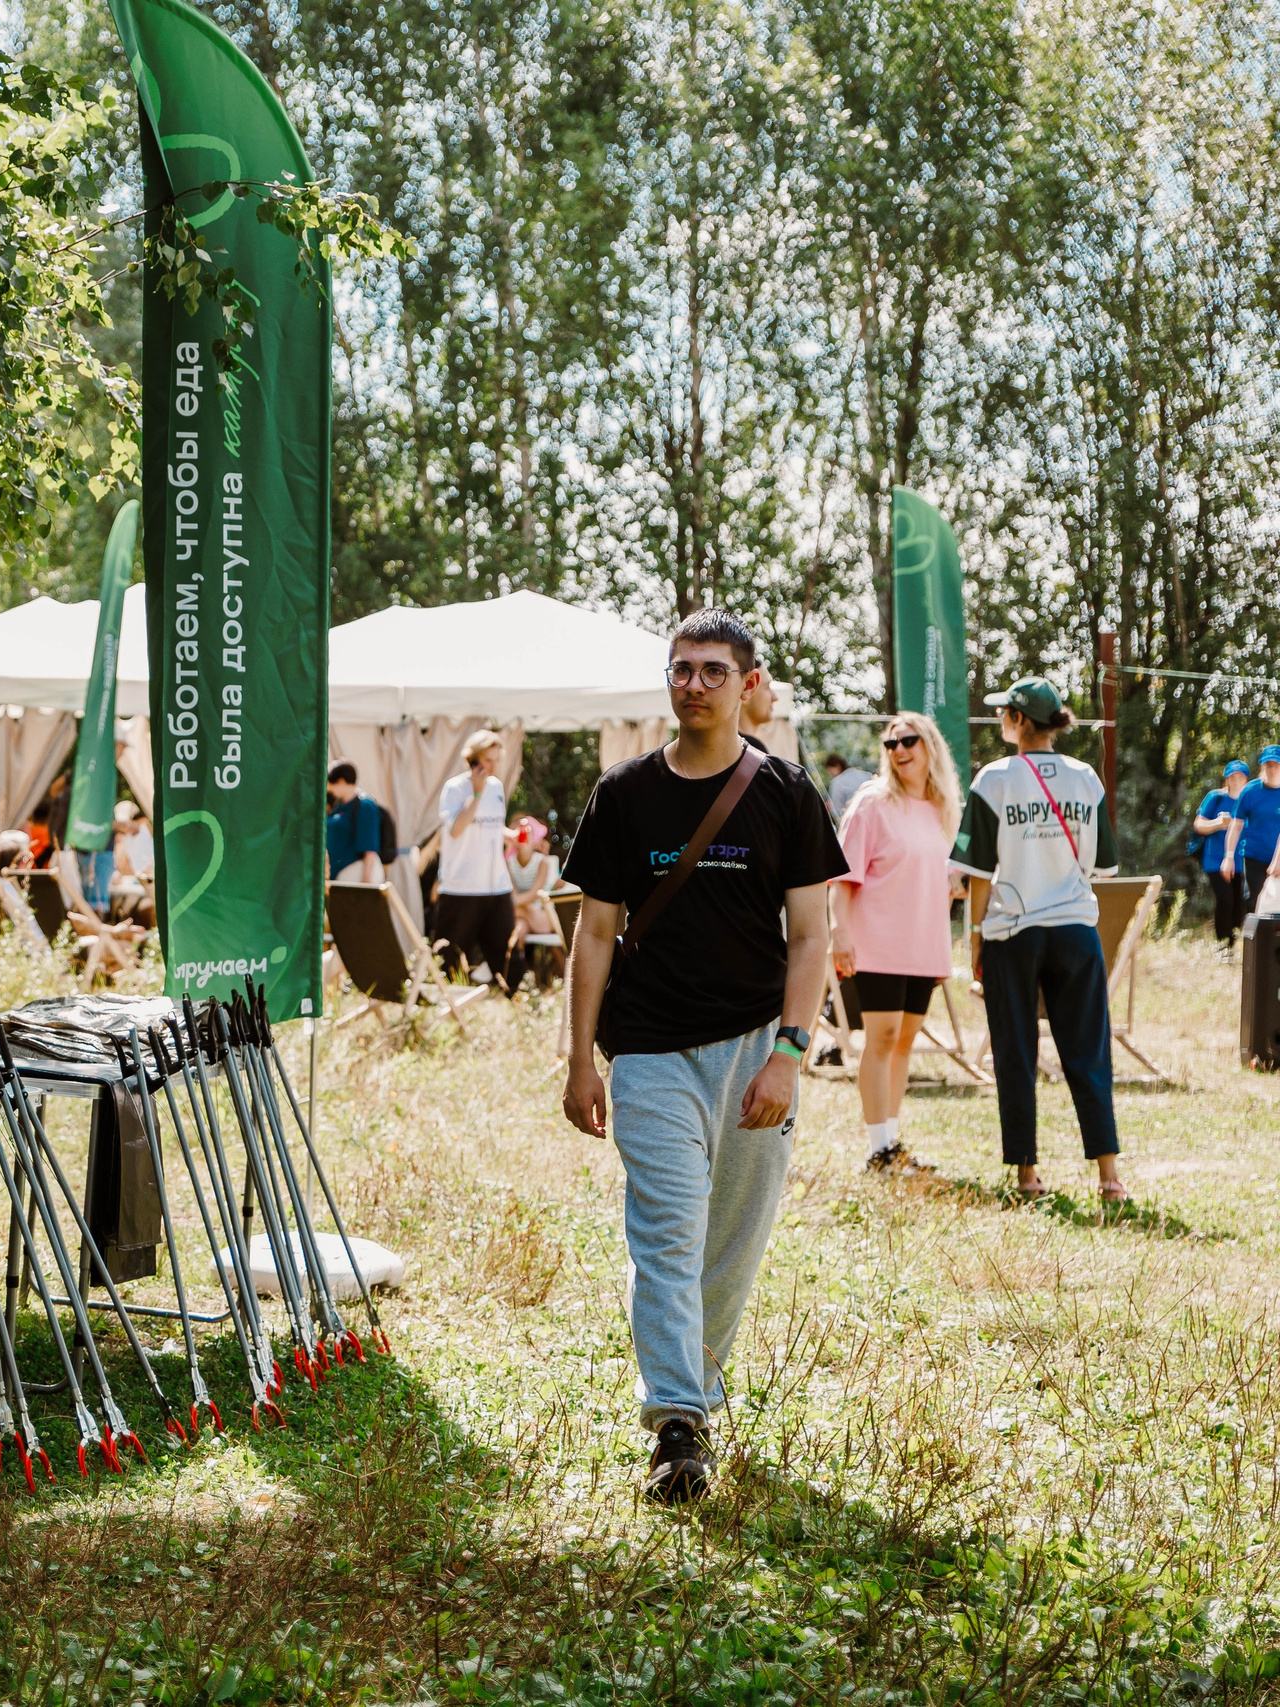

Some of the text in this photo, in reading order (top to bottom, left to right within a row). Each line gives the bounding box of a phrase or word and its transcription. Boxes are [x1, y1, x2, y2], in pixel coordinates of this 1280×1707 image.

[168, 341, 204, 788] Работаем, чтобы еда
[223, 472, 250, 672] доступна
[215, 684, 243, 789] была
[650, 843, 749, 866] Гостарт
[695, 860, 747, 870] осмолодёжь
[174, 957, 267, 989] ыручаем
